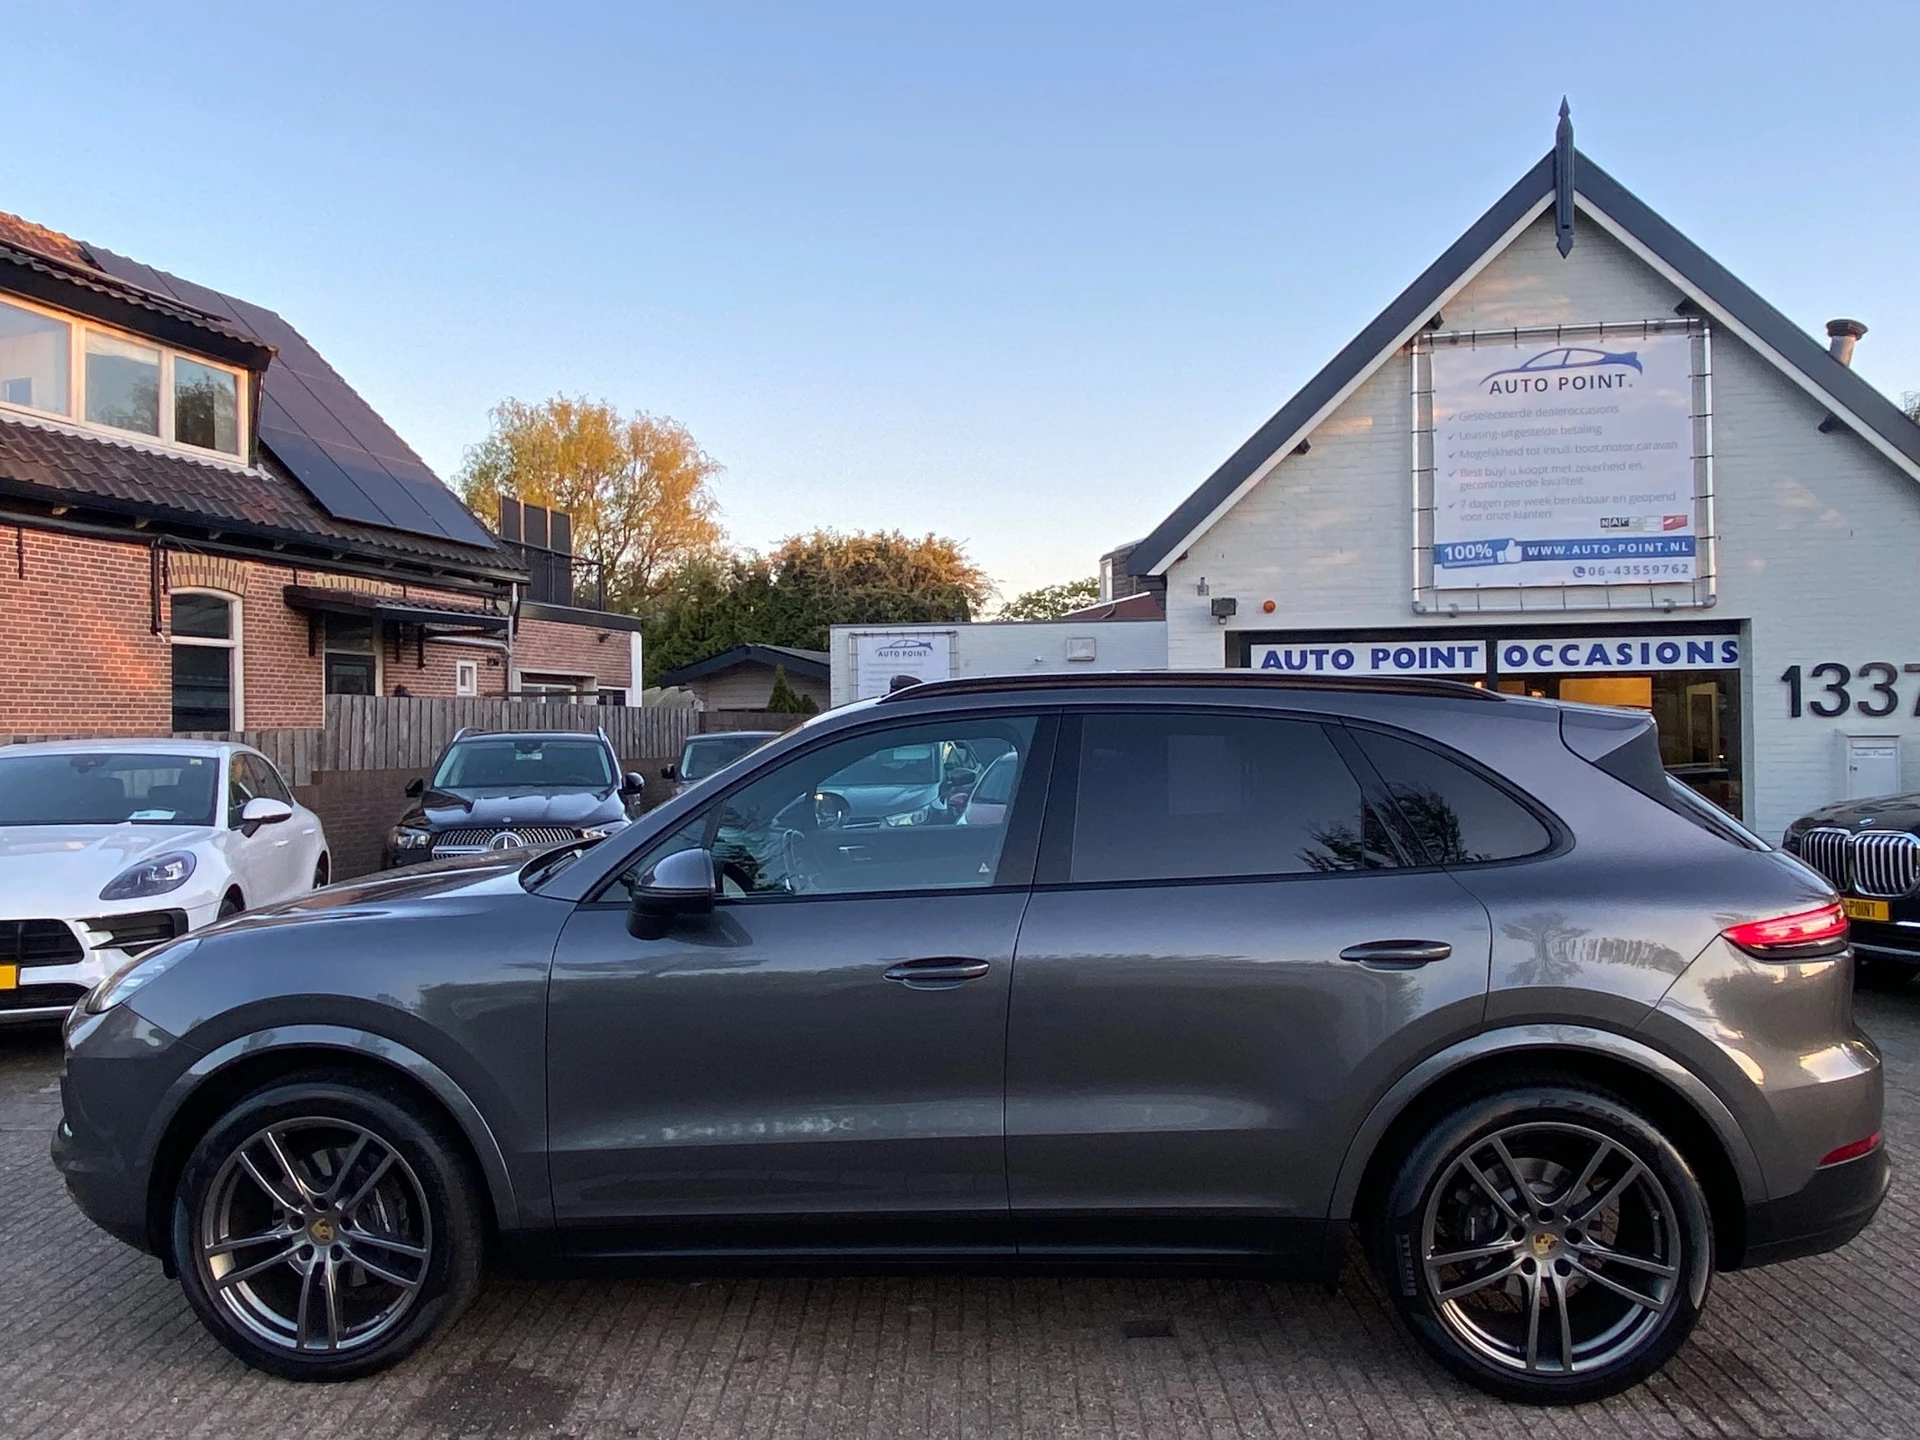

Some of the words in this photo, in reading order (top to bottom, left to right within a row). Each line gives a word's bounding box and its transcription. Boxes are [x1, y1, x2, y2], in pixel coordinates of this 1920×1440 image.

[1489, 377, 1548, 395] AUTO
[1459, 409, 1532, 421] Geselecteerde
[1535, 405, 1619, 417] dealeroccasions
[1560, 424, 1602, 436] betaling
[1460, 446, 1523, 460] Mogelijkheid
[1526, 447, 1541, 456] tot
[1460, 468, 1482, 477] Best
[1519, 465, 1548, 475] koopt
[1551, 465, 1572, 473] met
[1575, 461, 1625, 473] zekerheid
[1460, 480, 1538, 492] gecontroleerde
[1541, 476, 1583, 487] kwaliteit
[1460, 499, 1467, 509] 7
[1469, 499, 1500, 511] dagen
[1504, 499, 1520, 508] per
[1523, 496, 1551, 506] week
[1554, 494, 1610, 505] bereikbaar
[1613, 495, 1627, 504] en
[1628, 491, 1676, 505] geopend
[1461, 513, 1482, 521] voor
[1486, 512, 1511, 520] onze
[1514, 510, 1551, 519] klanten
[1444, 543, 1493, 560] 100%
[1588, 564, 1689, 576] 06-43559762
[1261, 649, 1354, 670] AUTO
[1371, 646, 1479, 670] POINT
[1503, 640, 1739, 667] OCCASIONS
